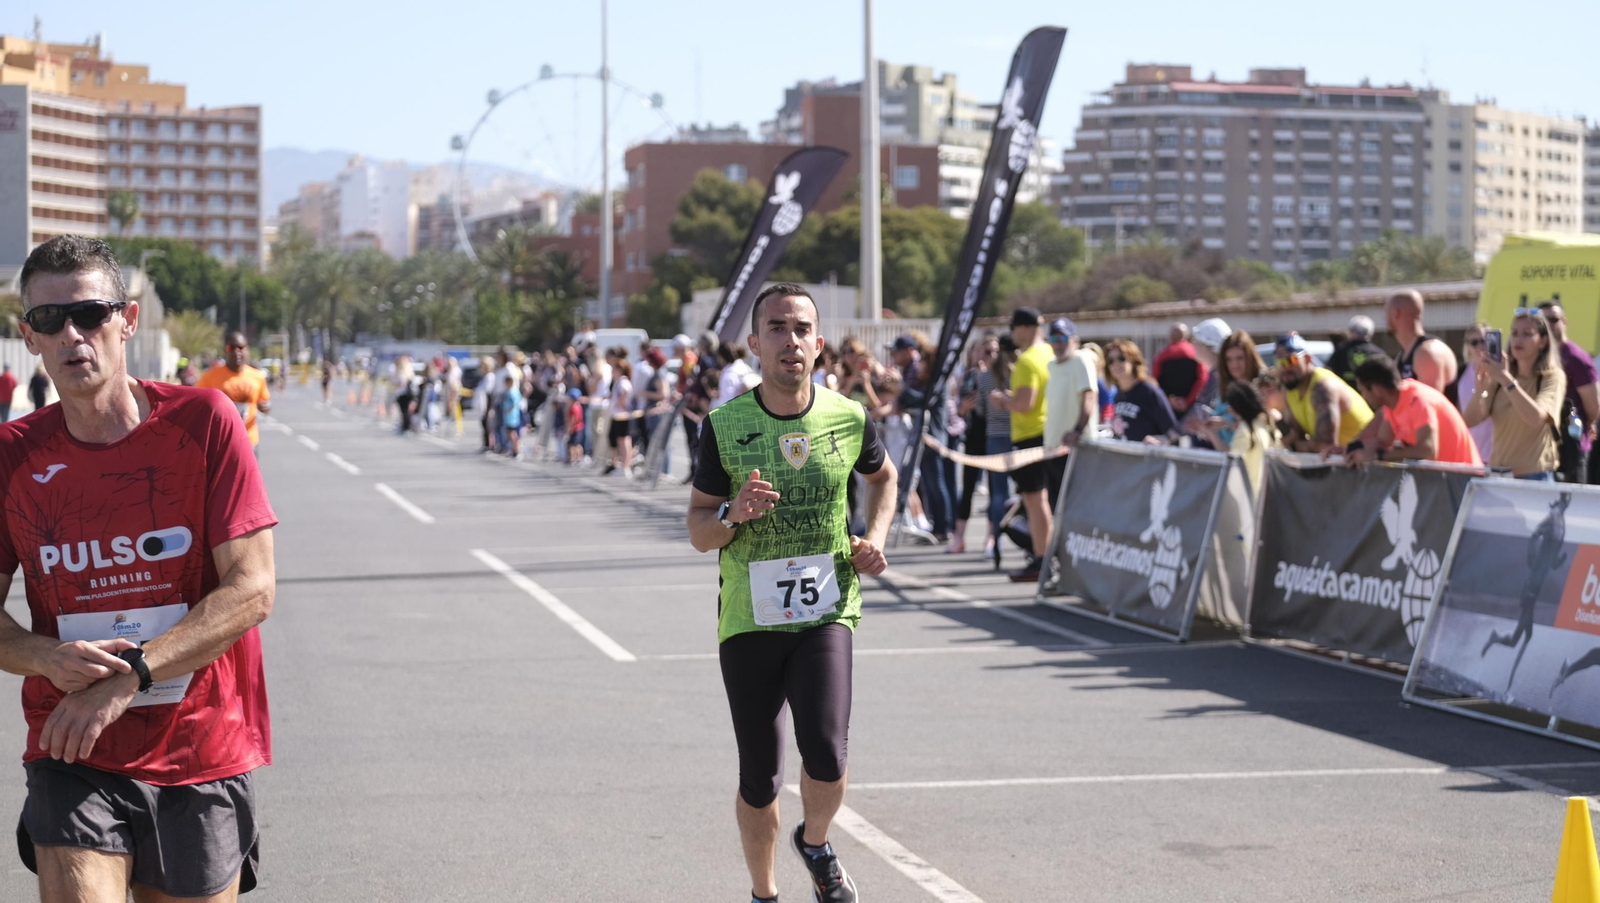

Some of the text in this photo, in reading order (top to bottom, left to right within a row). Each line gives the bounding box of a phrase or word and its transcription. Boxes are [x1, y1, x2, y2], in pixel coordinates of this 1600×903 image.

[1521, 264, 1595, 279] SOPORTE VITAL
[39, 525, 193, 575] PULSO
[90, 571, 152, 588] RUNNING
[776, 577, 820, 609] 75
